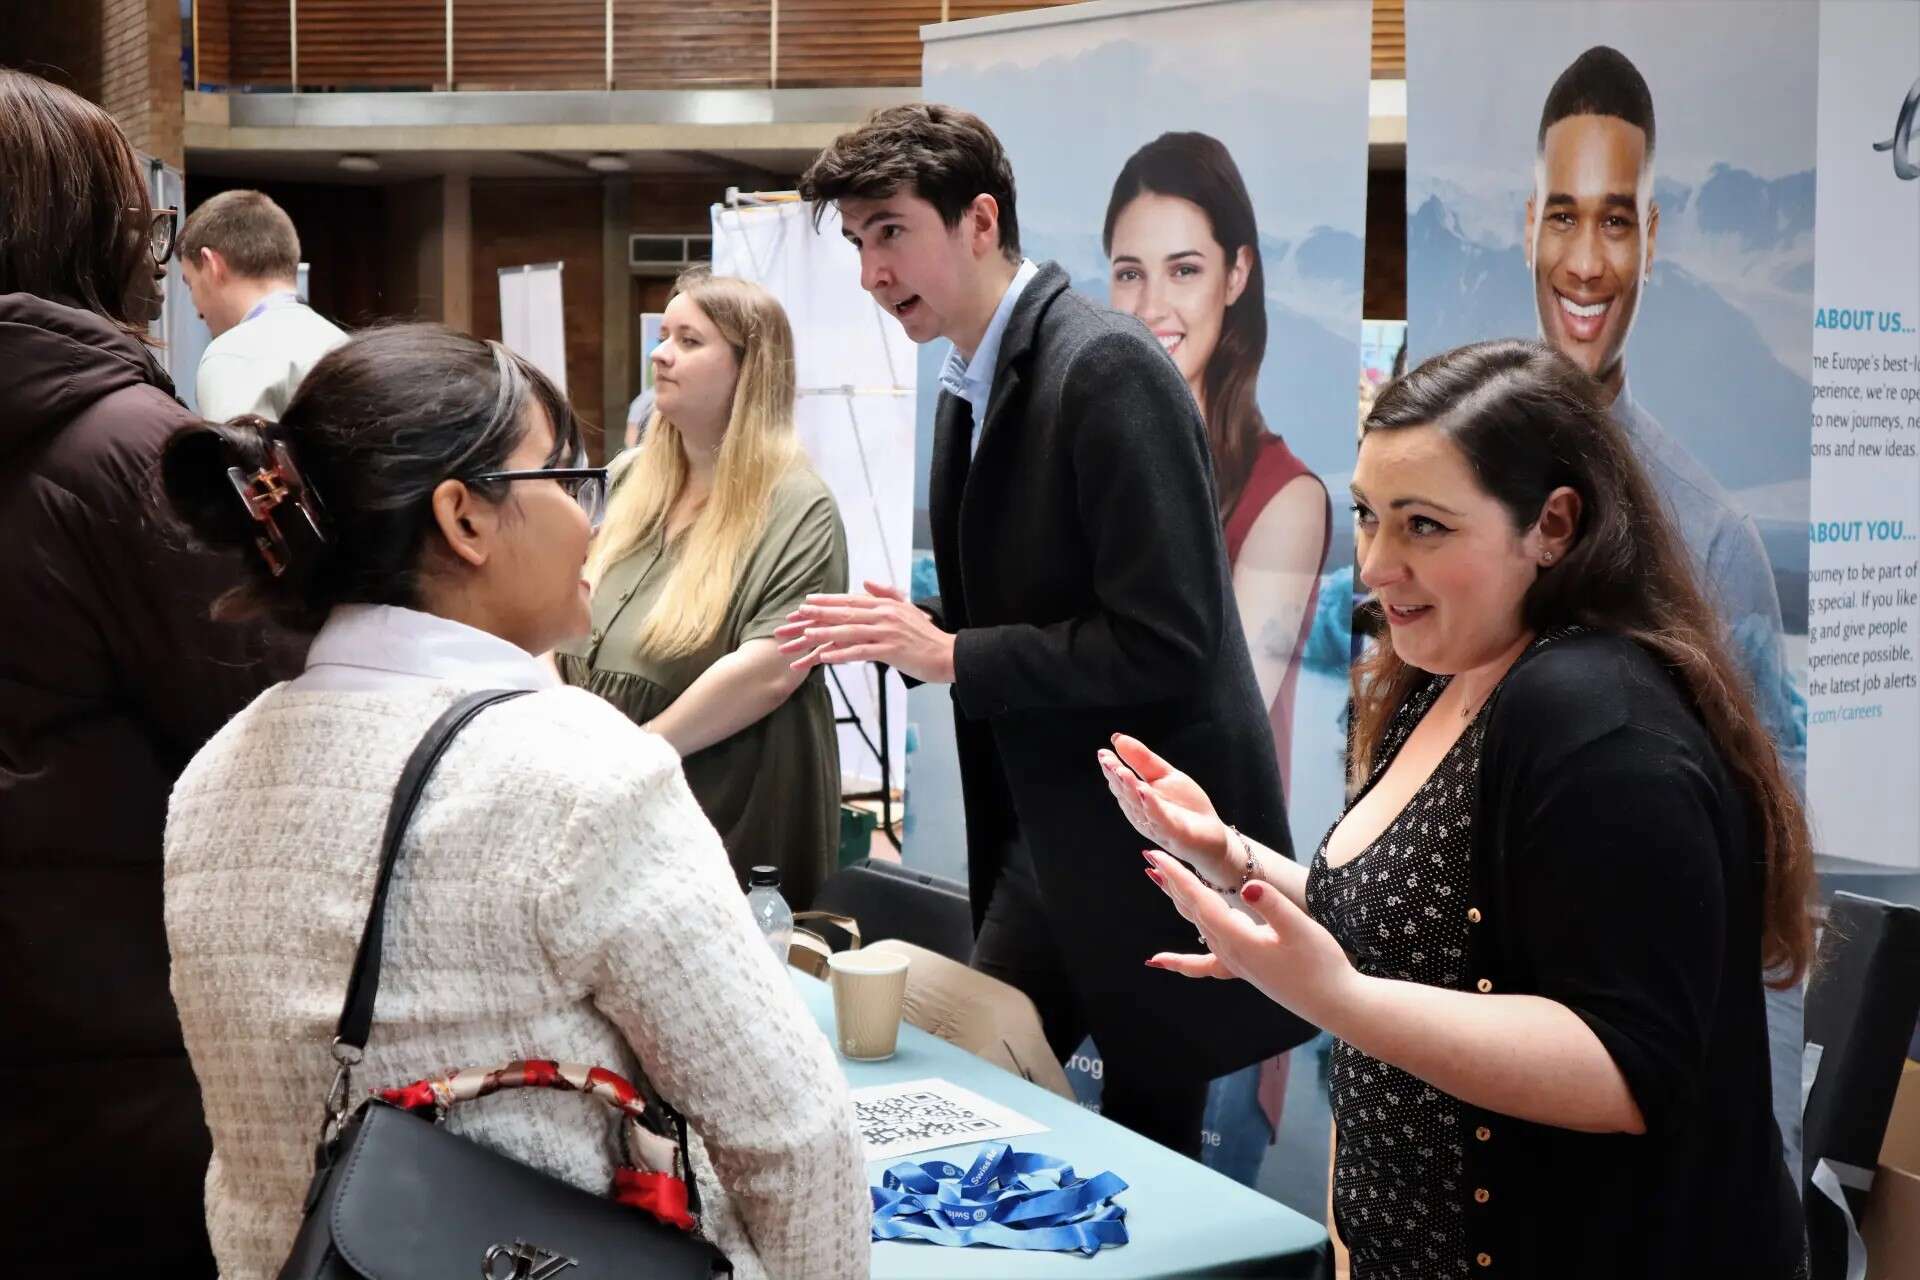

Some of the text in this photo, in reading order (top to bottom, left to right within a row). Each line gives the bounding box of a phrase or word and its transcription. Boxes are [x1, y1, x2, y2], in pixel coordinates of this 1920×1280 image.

[1815, 308, 1916, 333] ABOUT US...
[1832, 352, 1880, 374] Europe's
[1866, 384, 1898, 400] we're
[1827, 415, 1849, 428] new
[1851, 410, 1904, 433] journeys,
[1834, 439, 1855, 457] and
[1858, 443, 1882, 457] new
[1885, 440, 1919, 457] ideas.
[1808, 521, 1916, 543] ABOUT YOU...
[1847, 565, 1858, 581] to
[1862, 563, 1875, 580] be
[1878, 565, 1901, 583] part
[1905, 562, 1919, 578] of
[1818, 591, 1858, 613] special.
[1861, 591, 1872, 607] If
[1872, 594, 1893, 611] you
[1896, 589, 1918, 606] like
[1820, 622, 1841, 639] and
[1843, 622, 1866, 642] give
[1868, 617, 1908, 640] people
[1809, 673, 1917, 696] the latest job alerts
[1808, 703, 1883, 725] .com/careers
[1065, 1054, 1103, 1079] rog
